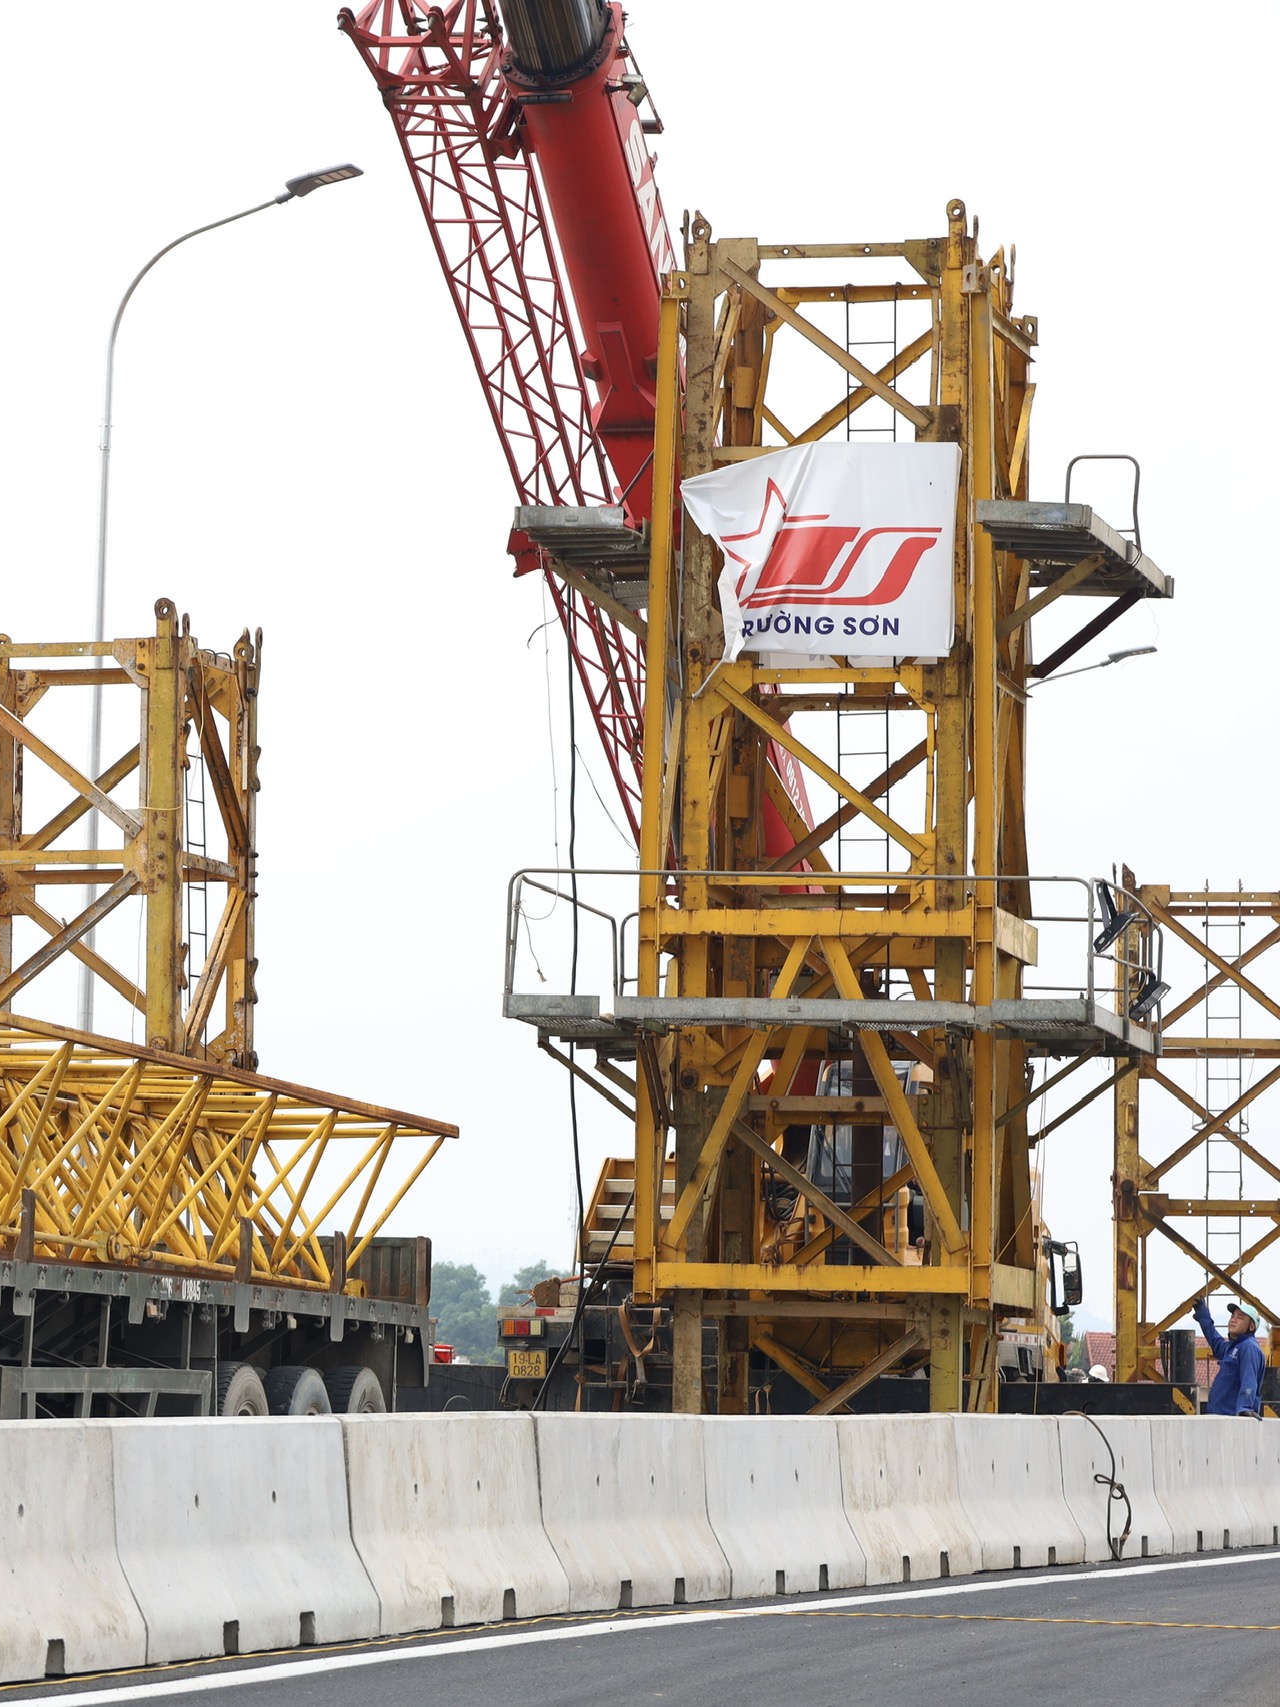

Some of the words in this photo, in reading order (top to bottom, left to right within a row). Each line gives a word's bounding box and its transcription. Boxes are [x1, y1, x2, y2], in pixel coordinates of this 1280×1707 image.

[741, 609, 835, 637] RƯỜNG
[842, 614, 900, 636] SƠN
[513, 1365, 540, 1377] 0828
